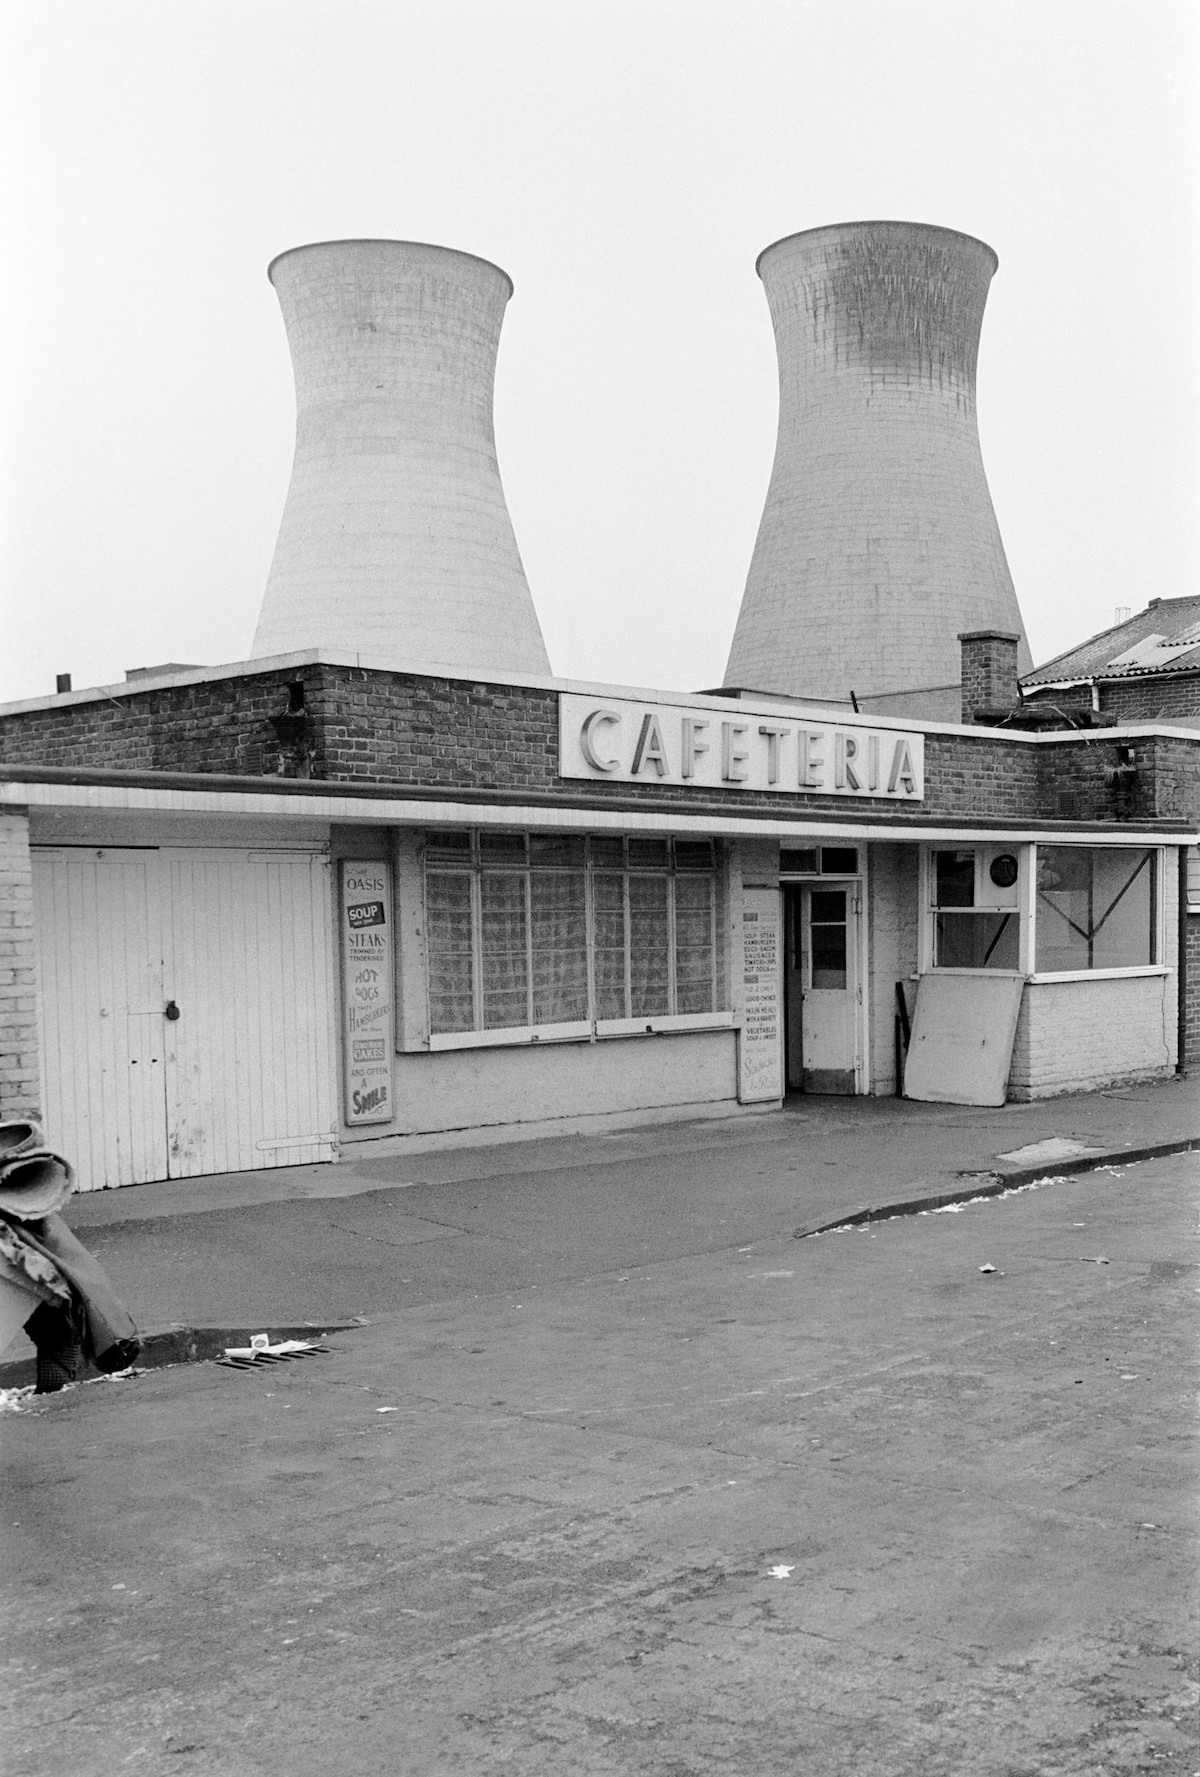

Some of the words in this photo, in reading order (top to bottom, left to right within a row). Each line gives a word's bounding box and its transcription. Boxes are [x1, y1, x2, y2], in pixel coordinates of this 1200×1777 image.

[580, 709, 917, 793] CAFETERIA
[347, 878, 384, 891] OASIS
[349, 905, 378, 921] SOUP
[348, 933, 387, 947] STEAKS
[355, 968, 379, 983] HOT
[355, 986, 379, 1001] DOGS
[746, 1007, 760, 1015] MAIN
[746, 1026, 776, 1034] VEGETABLES
[354, 1048, 384, 1061] CAKES
[351, 1069, 365, 1077] AND
[367, 1067, 388, 1076] OFTEN
[361, 1078, 368, 1088] A
[353, 1086, 387, 1115] SMILE
